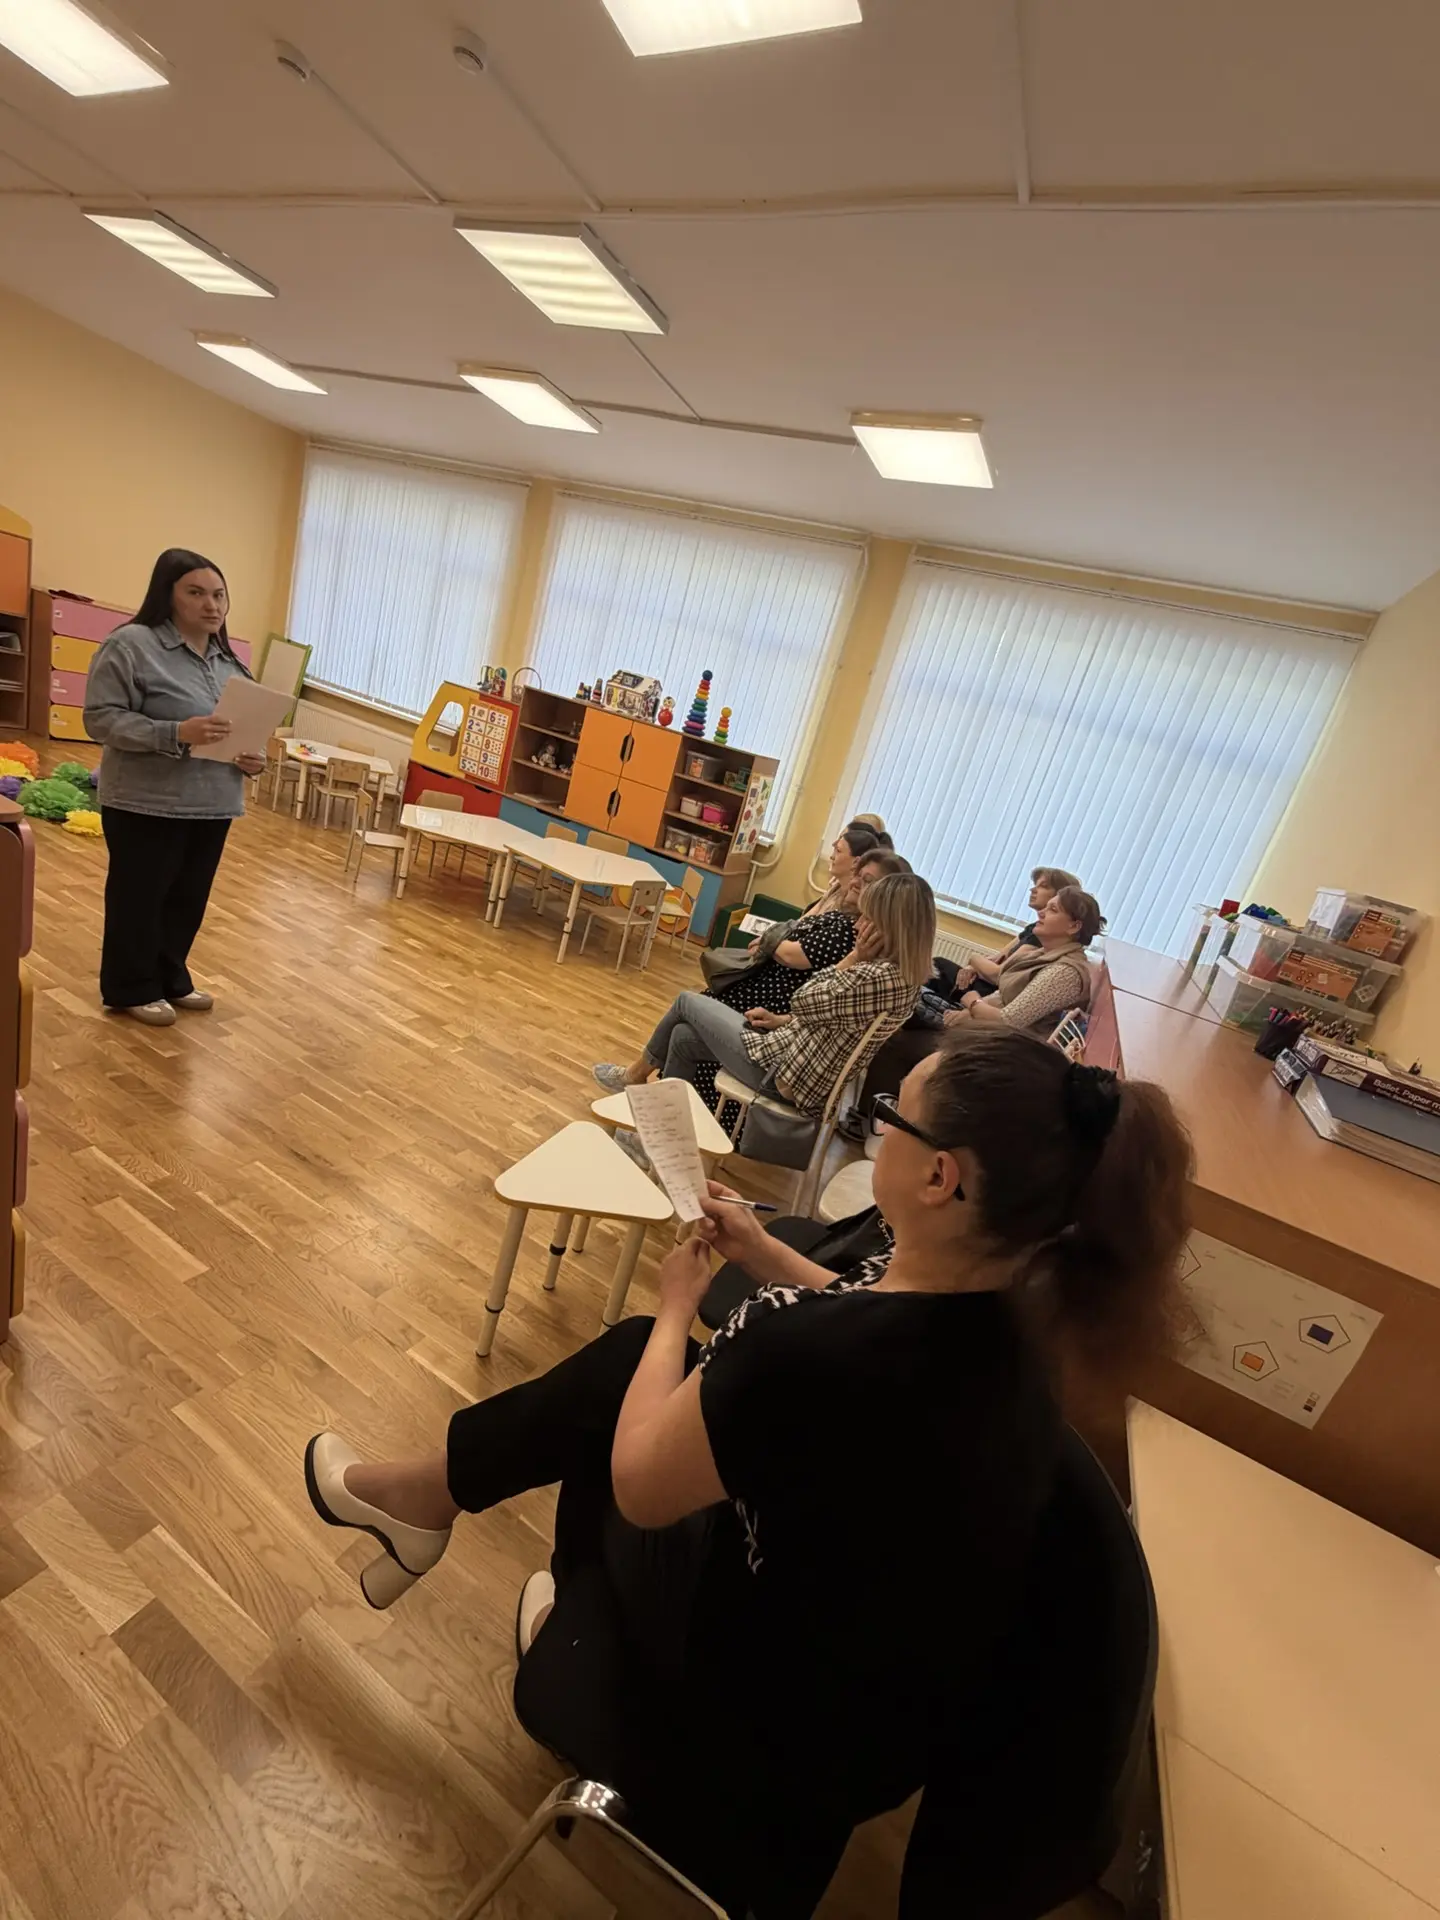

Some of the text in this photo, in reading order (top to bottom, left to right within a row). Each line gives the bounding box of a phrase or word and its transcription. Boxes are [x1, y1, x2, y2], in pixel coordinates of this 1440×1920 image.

[471, 706, 476, 716] 1
[489, 712, 496, 722] 6
[468, 719, 474, 730] 2
[487, 725, 494, 735] 7
[465, 732, 471, 742] 3
[484, 739, 491, 750] 8
[462, 747, 469, 758] 4
[482, 752, 488, 763] 9
[461, 759, 467, 769] 5
[480, 766, 489, 778] 10
[1402, 1089, 1432, 1105] Paper
